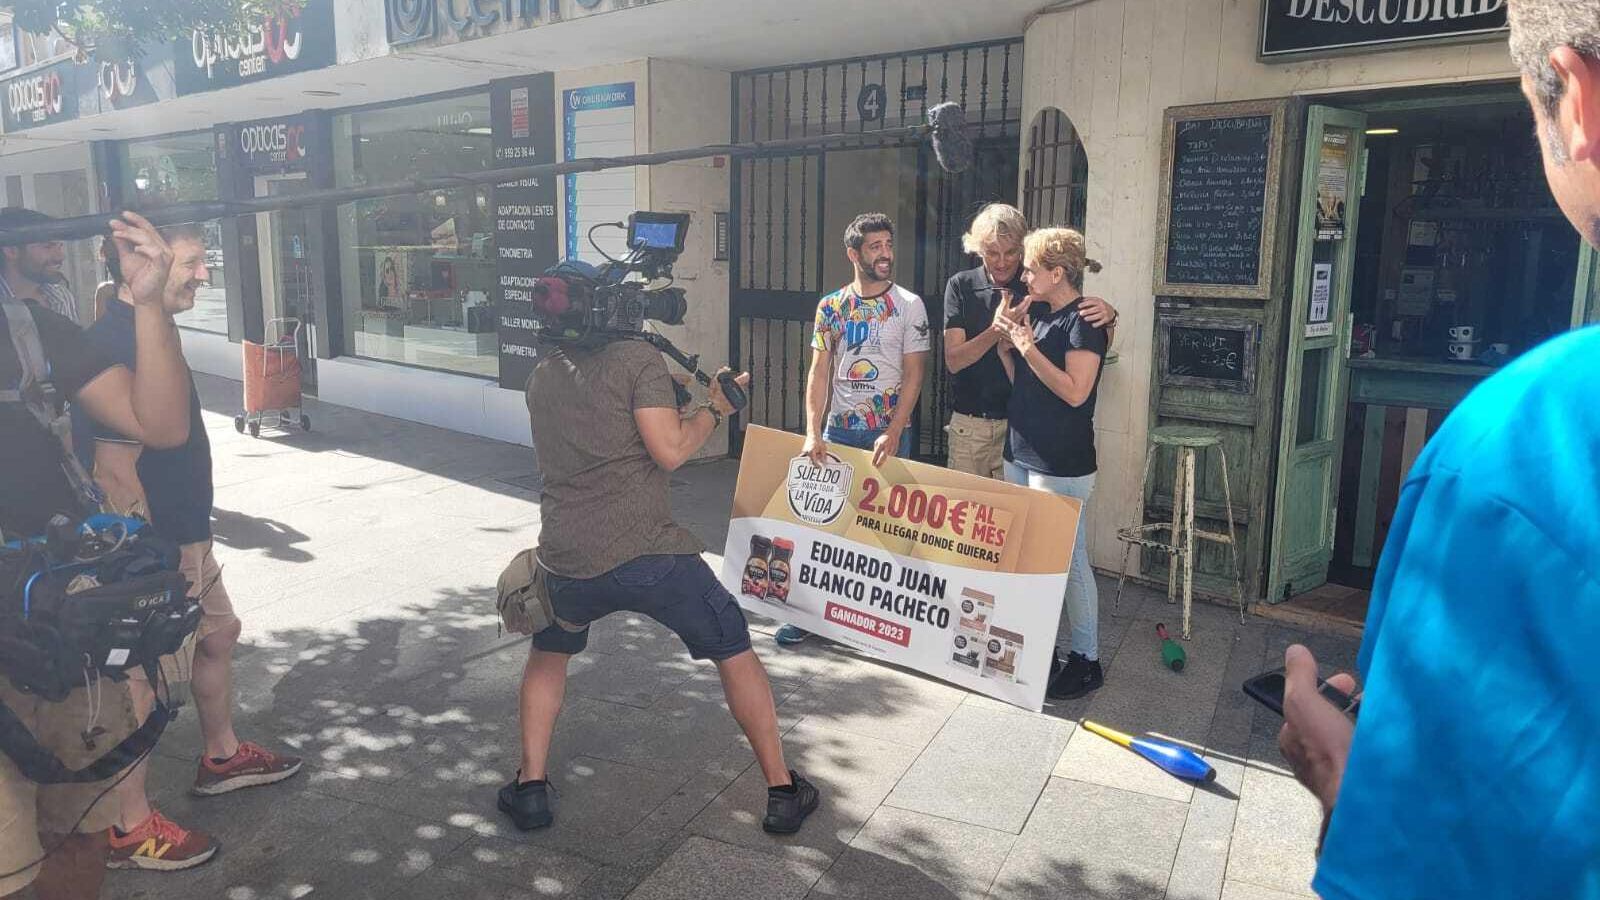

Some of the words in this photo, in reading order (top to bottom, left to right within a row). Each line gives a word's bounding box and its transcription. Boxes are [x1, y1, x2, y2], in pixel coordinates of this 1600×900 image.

[238, 56, 266, 77] center
[863, 89, 879, 118] 4
[532, 204, 554, 216] LENTES
[498, 219, 505, 231] DE
[506, 219, 535, 231] CONTACTO
[500, 275, 540, 288] ADAPTACIONE
[501, 316, 520, 329] TALLER
[521, 318, 542, 330] MONTA
[794, 465, 841, 484] SUELDO
[794, 490, 805, 501] LA
[802, 481, 817, 491] PARA
[856, 514, 881, 532] PARA
[883, 521, 919, 542] LLEGAR
[921, 532, 955, 552] DONDE
[956, 542, 1001, 564] QUIERAS
[971, 524, 1006, 547] MES
[810, 540, 893, 583] EDUARDO
[897, 566, 947, 600] JUAN
[799, 563, 866, 602] BLANCO
[869, 585, 950, 630] PACHECO
[830, 606, 876, 632] GANADOR
[879, 622, 904, 642] 2023
